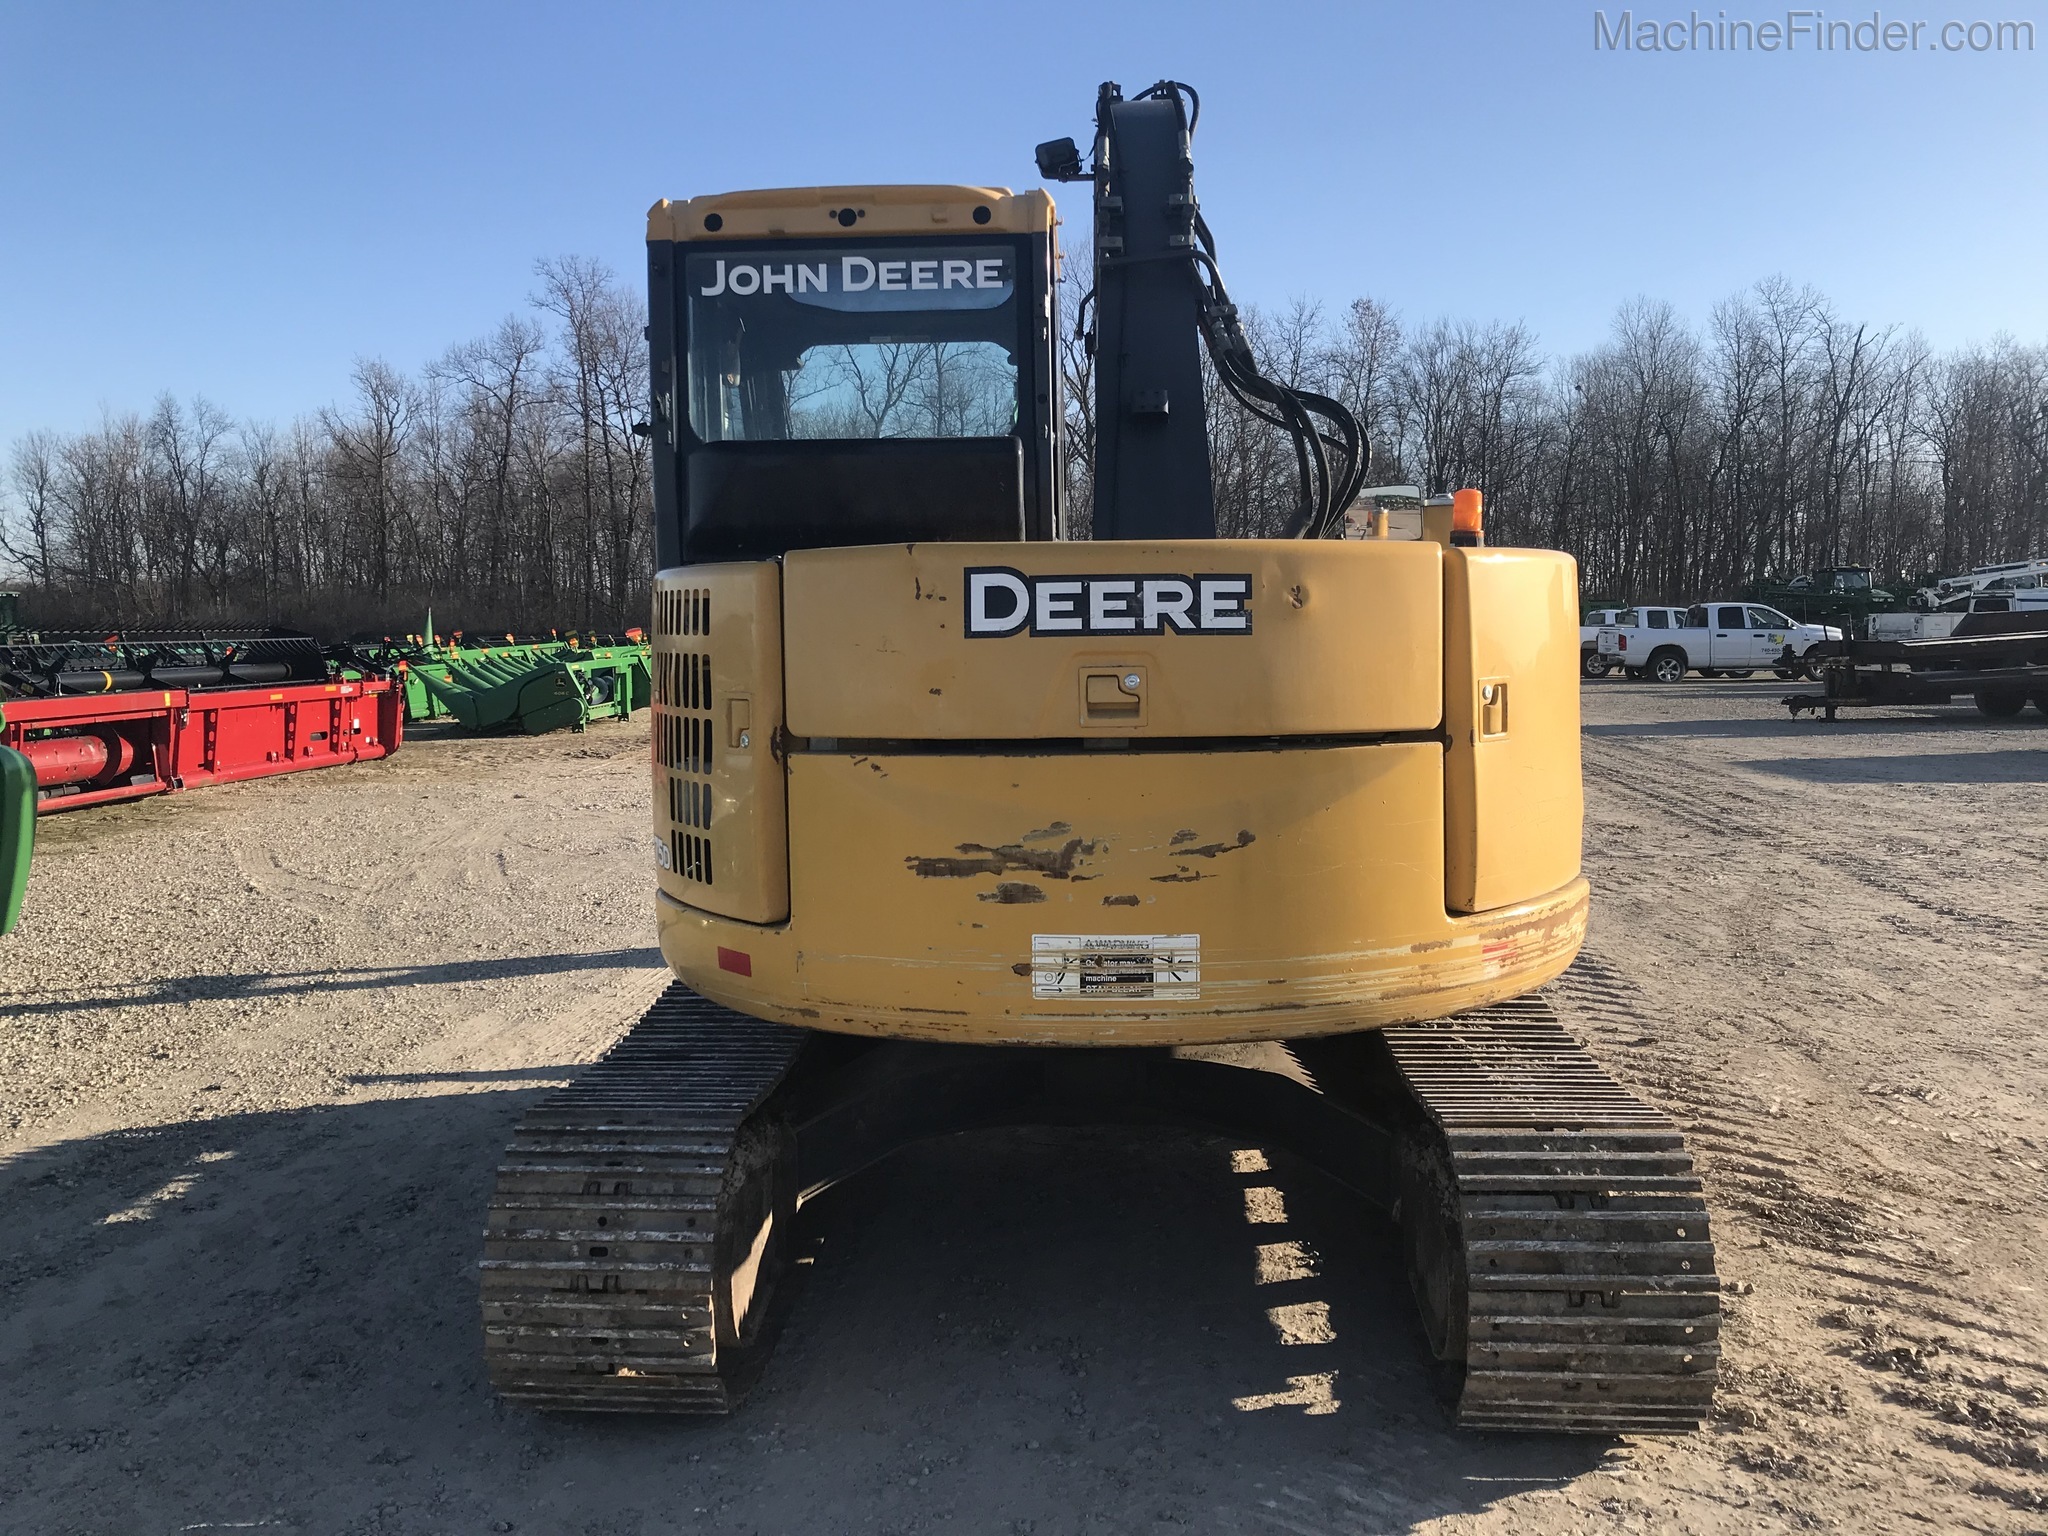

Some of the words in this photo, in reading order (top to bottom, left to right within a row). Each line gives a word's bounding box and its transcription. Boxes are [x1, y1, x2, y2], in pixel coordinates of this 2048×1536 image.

[701, 260, 828, 297] JOHN
[841, 257, 1004, 292] DEERE
[969, 573, 1247, 632] DEERE
